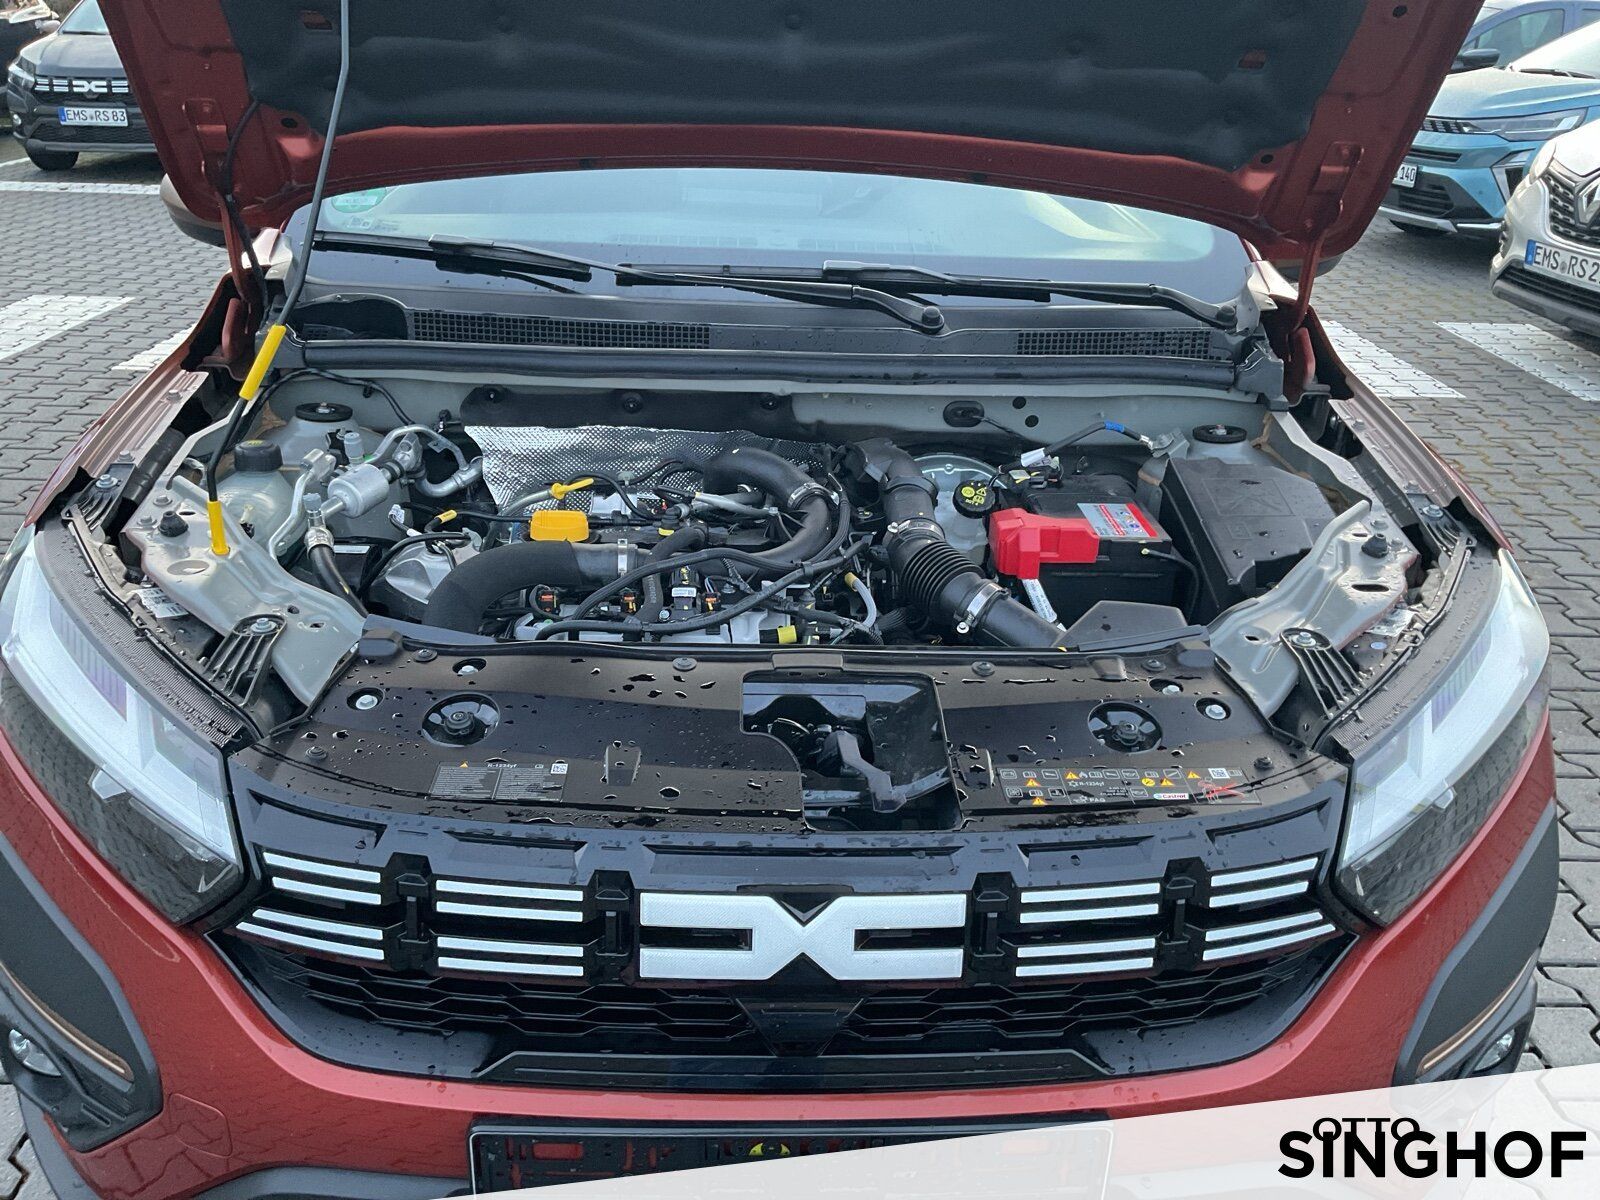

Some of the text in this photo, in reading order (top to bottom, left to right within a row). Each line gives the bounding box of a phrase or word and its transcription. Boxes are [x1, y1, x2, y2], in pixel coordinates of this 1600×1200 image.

[66, 109, 126, 122] EMS RS 83
[1400, 166, 1416, 182] 140
[1533, 245, 1600, 284] EMS RS 2
